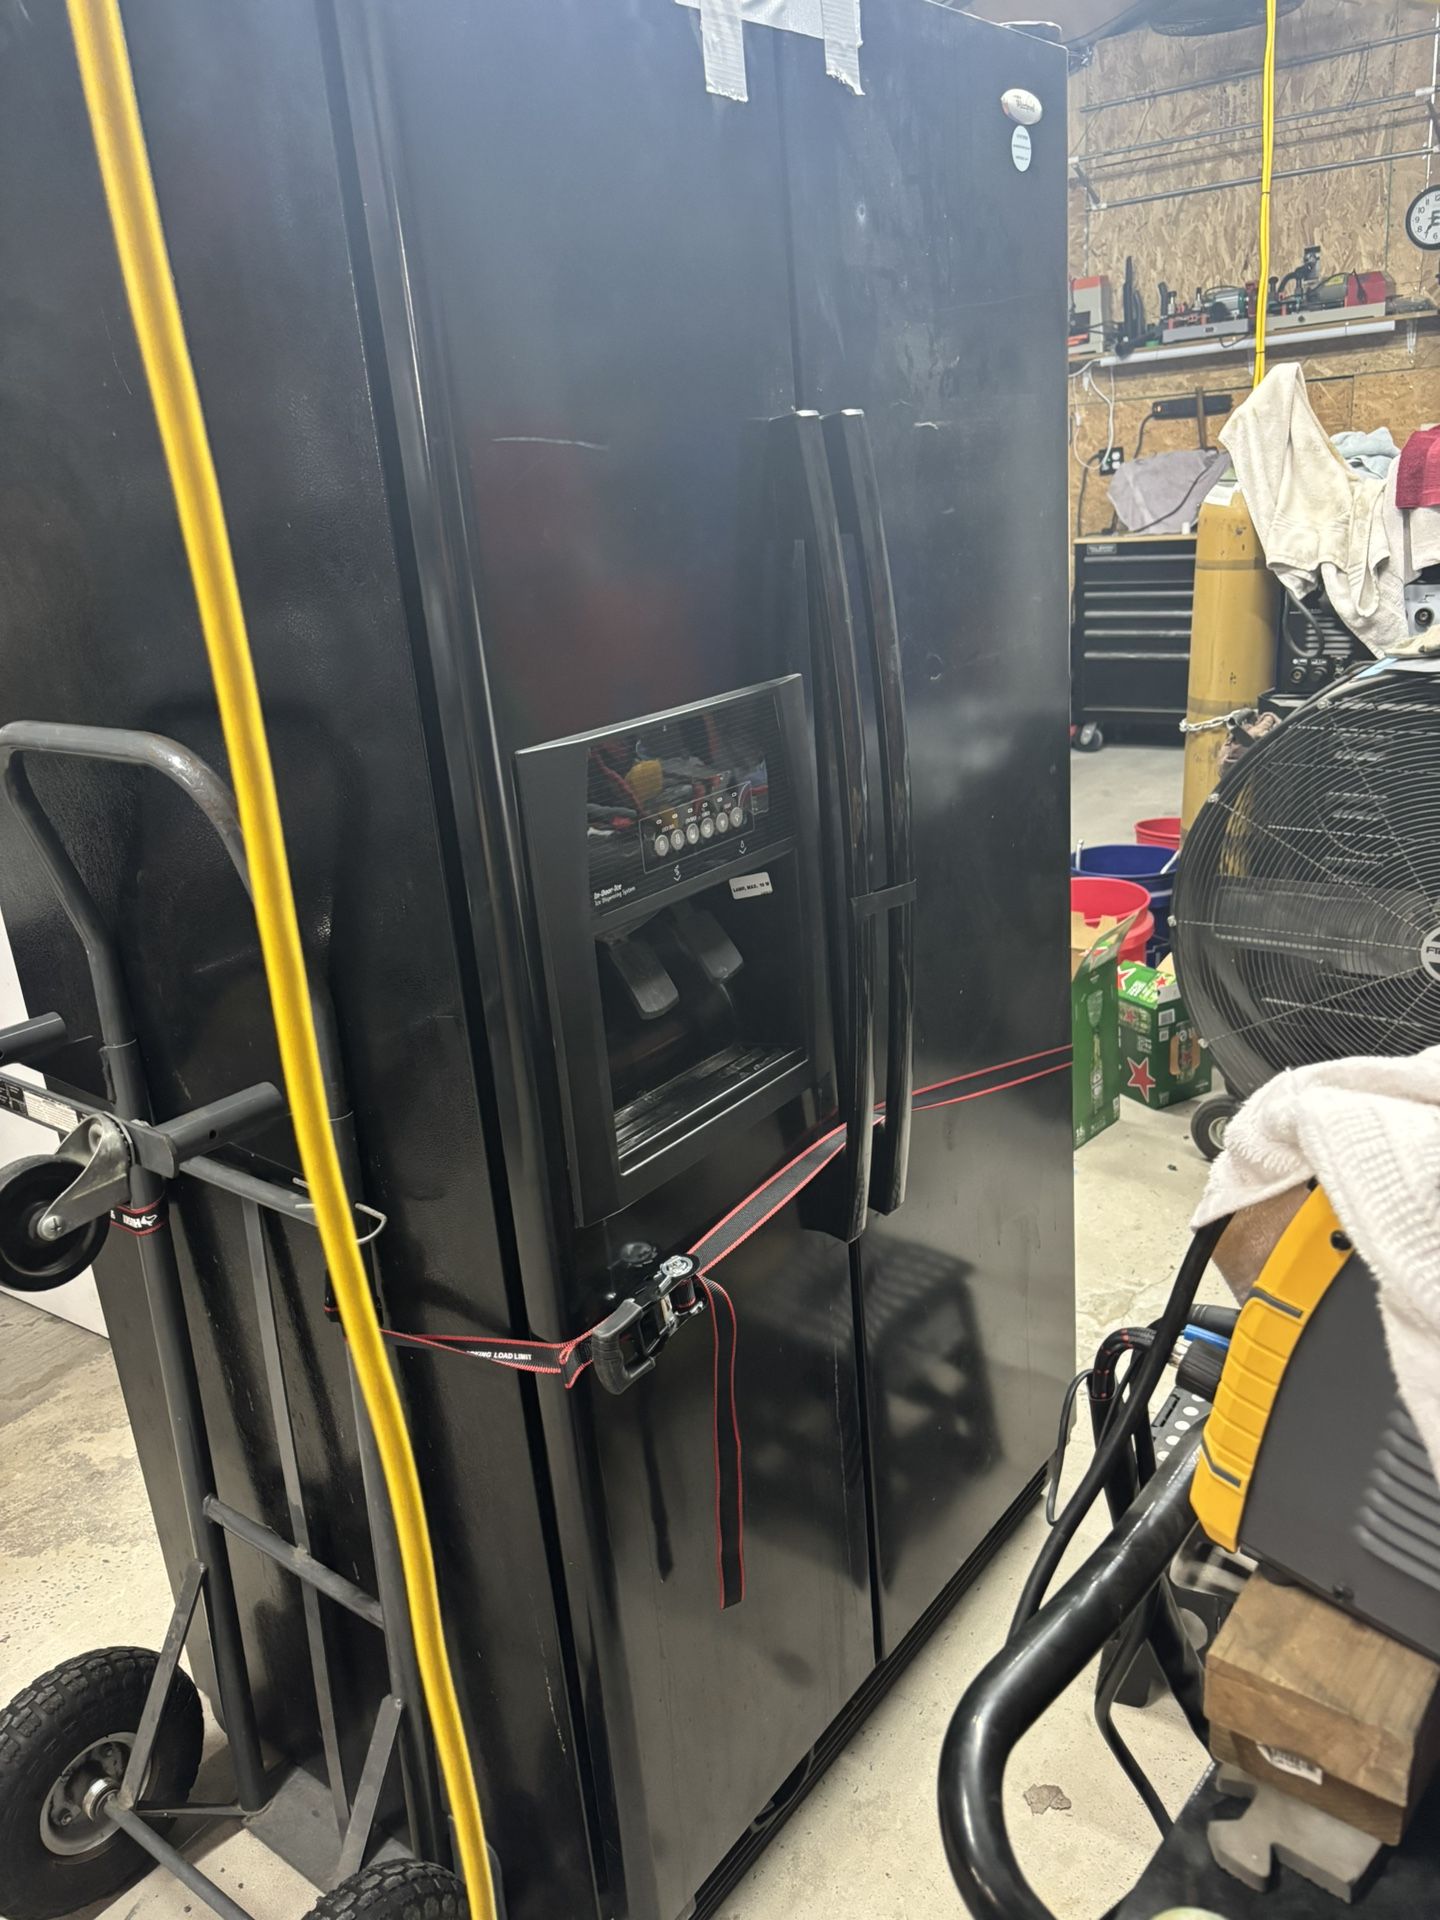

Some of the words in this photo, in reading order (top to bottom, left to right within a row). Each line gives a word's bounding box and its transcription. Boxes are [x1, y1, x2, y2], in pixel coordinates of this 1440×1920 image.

[1418, 206, 1425, 214] 10
[493, 1351, 514, 1360] LOAD
[513, 1352, 532, 1361] LIMIT
